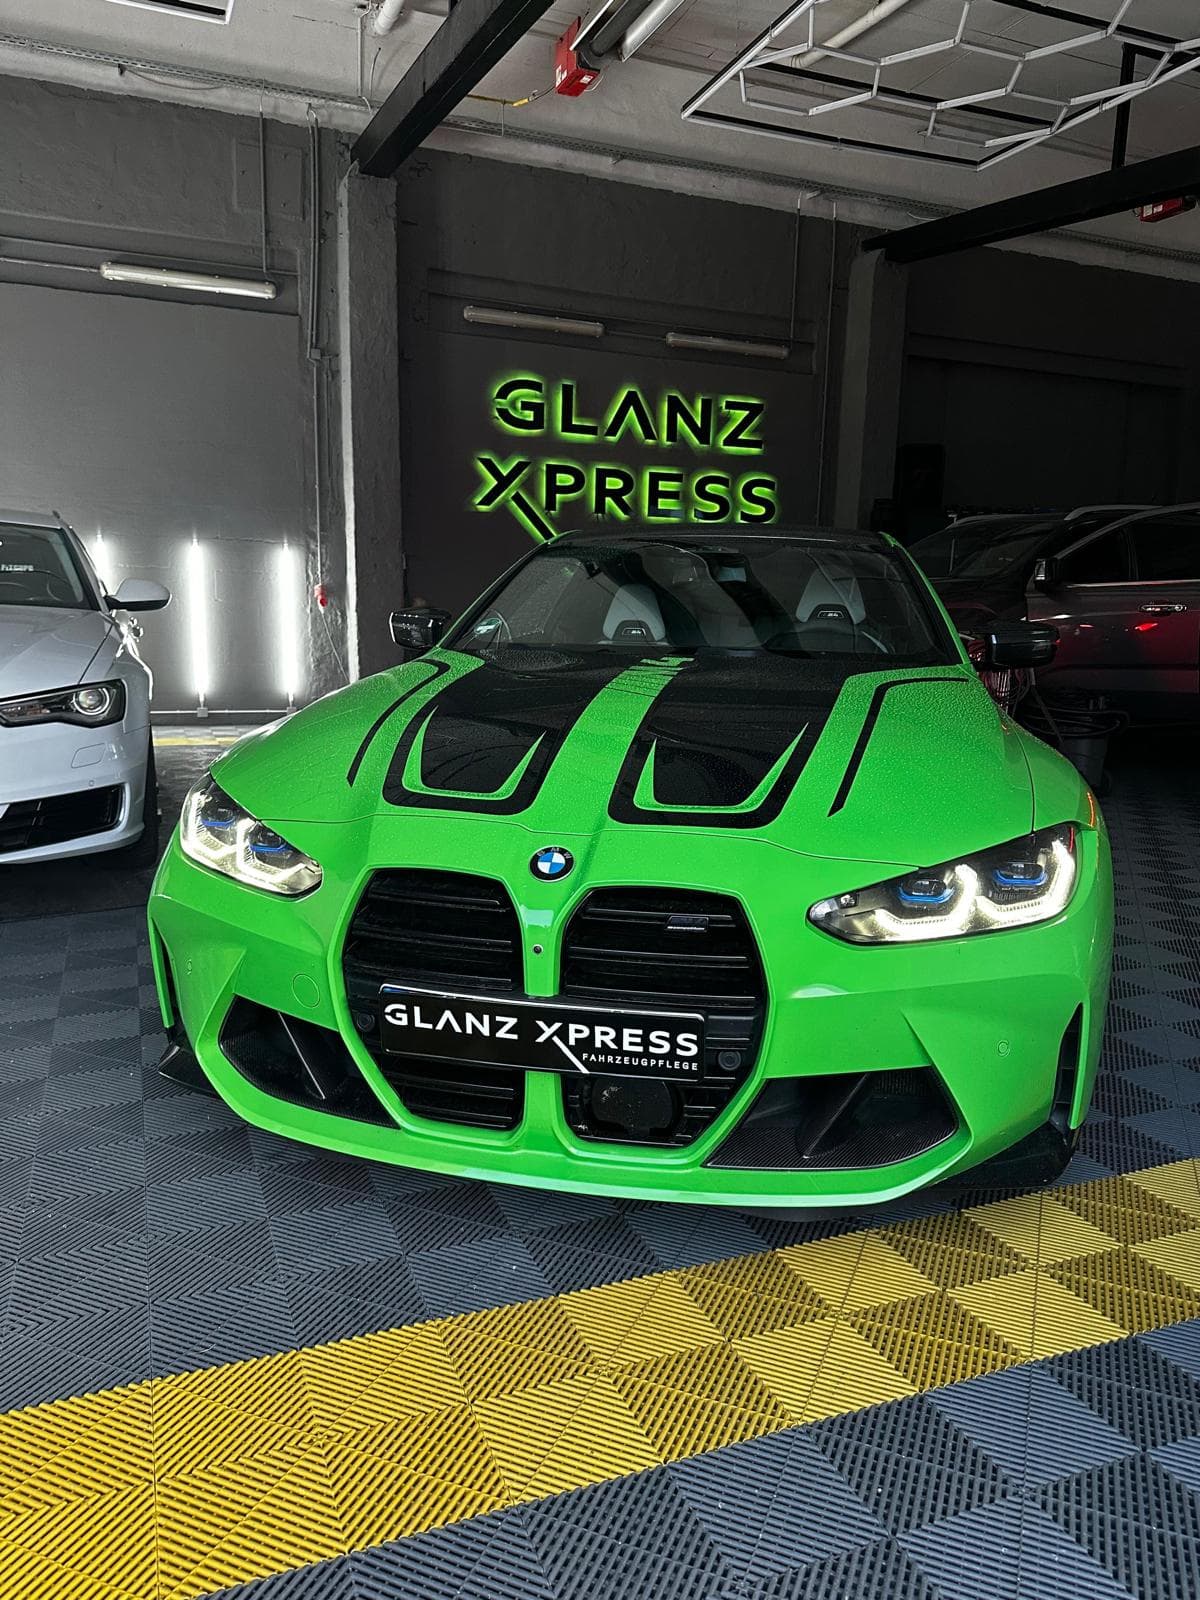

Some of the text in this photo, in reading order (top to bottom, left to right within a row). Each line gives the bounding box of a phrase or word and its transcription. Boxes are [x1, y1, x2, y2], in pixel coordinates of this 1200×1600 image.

[494, 378, 765, 450] GLANZ
[475, 456, 778, 541] XPRESS
[384, 1003, 699, 1074] GLANZ XPRESS
[582, 1053, 699, 1071] FAHRZEUGPFLEGE
